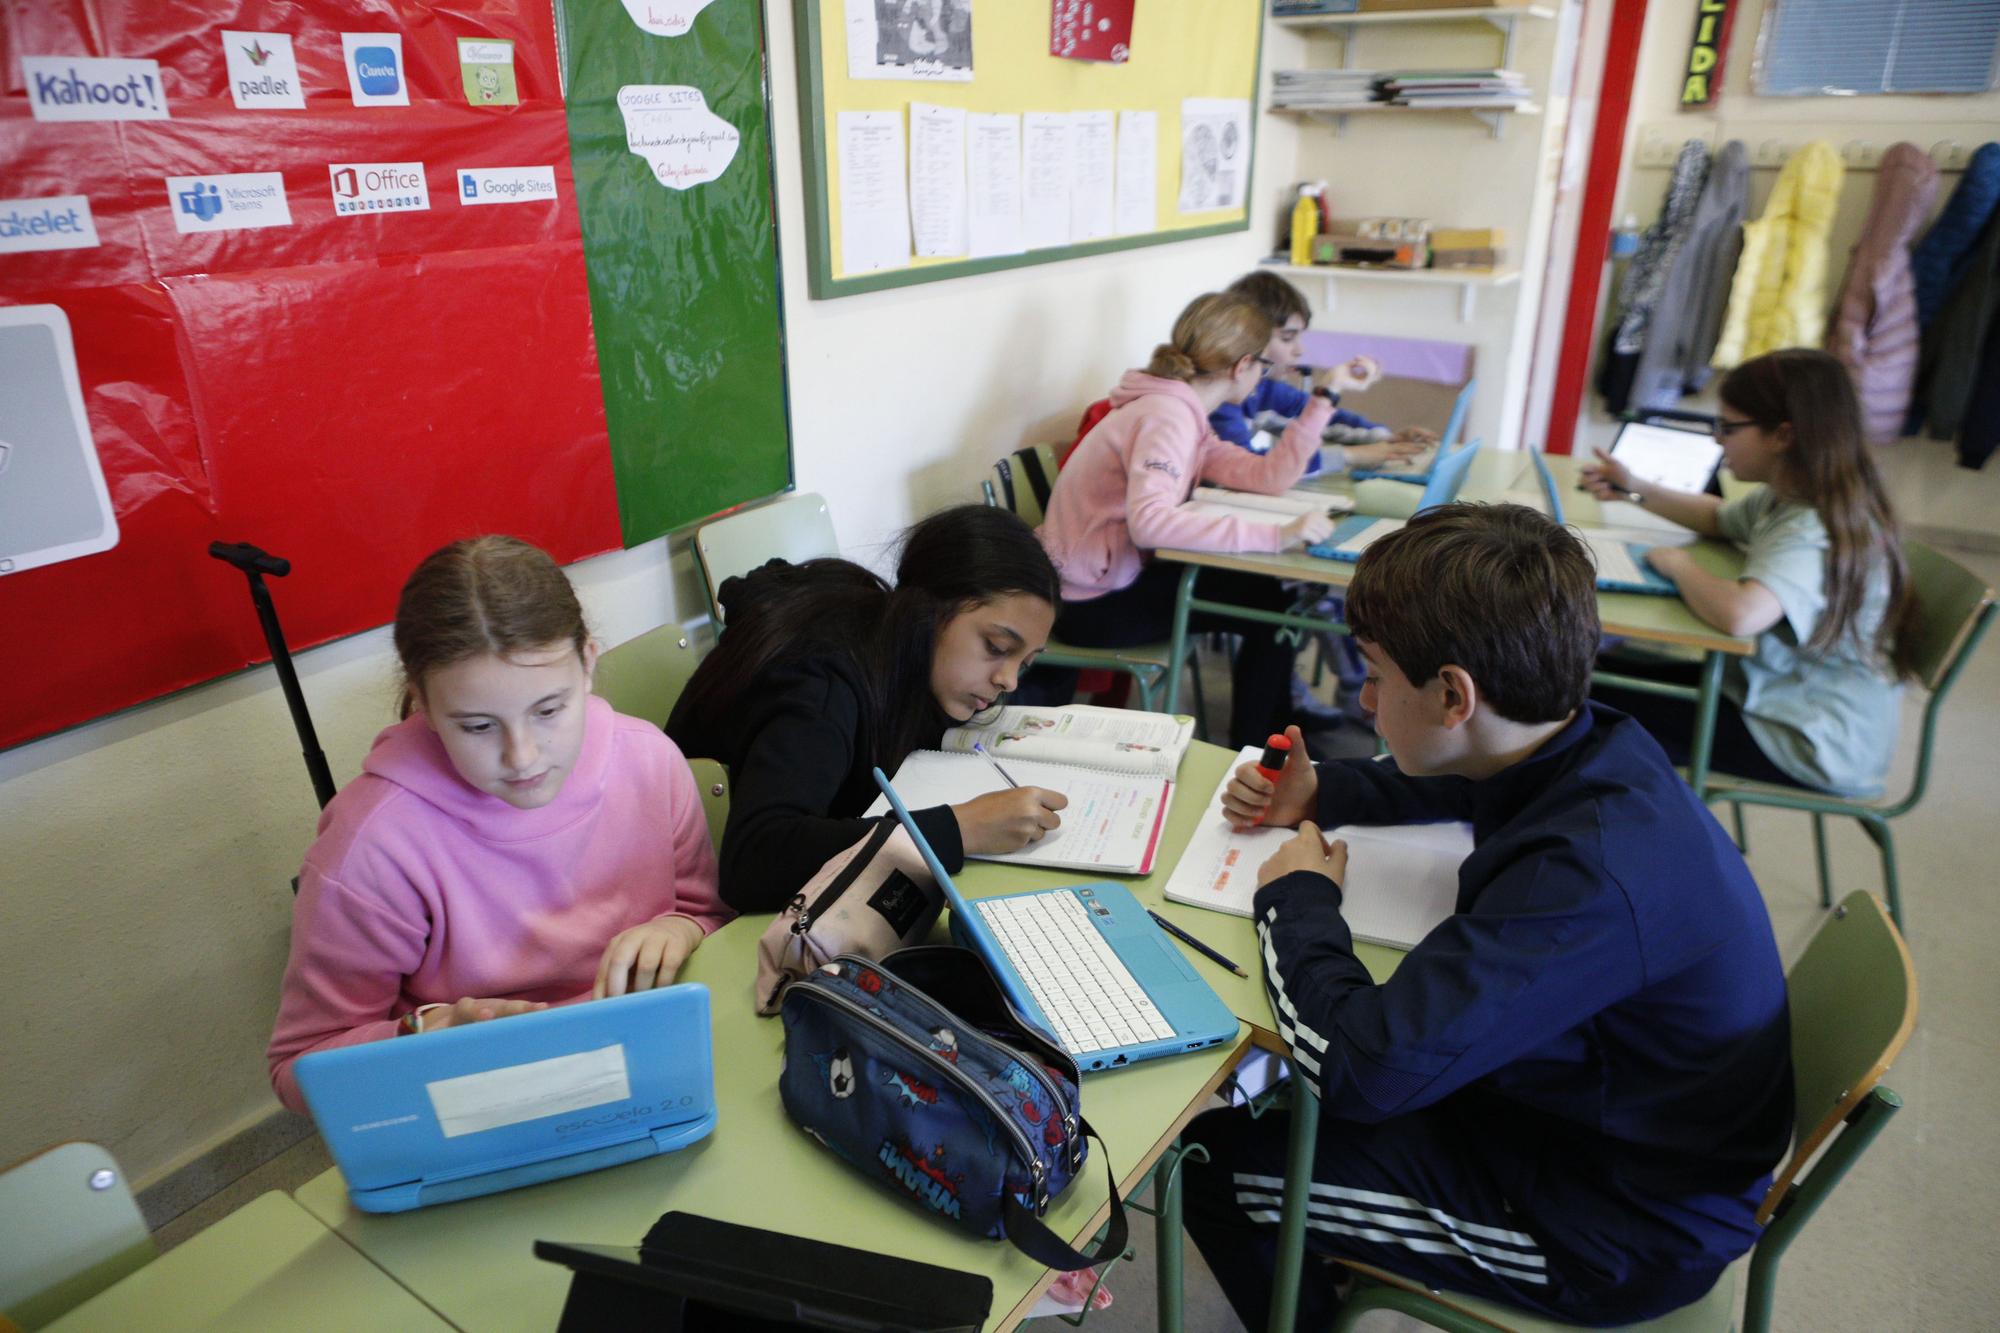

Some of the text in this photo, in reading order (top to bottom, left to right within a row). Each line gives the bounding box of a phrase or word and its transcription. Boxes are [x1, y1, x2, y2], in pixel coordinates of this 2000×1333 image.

[359, 63, 395, 78] Canva
[34, 68, 159, 110] Kahoot!
[238, 76, 290, 100] padlet
[620, 87, 701, 105] GOOGLE SITES
[365, 169, 419, 191] Office
[483, 179, 553, 196] Google Sites
[225, 185, 276, 199] Microsoft
[228, 200, 263, 211] Teams
[555, 1106, 653, 1134] escuela
[660, 1095, 693, 1111] 2.0
[879, 1141, 961, 1220] WHAM!
